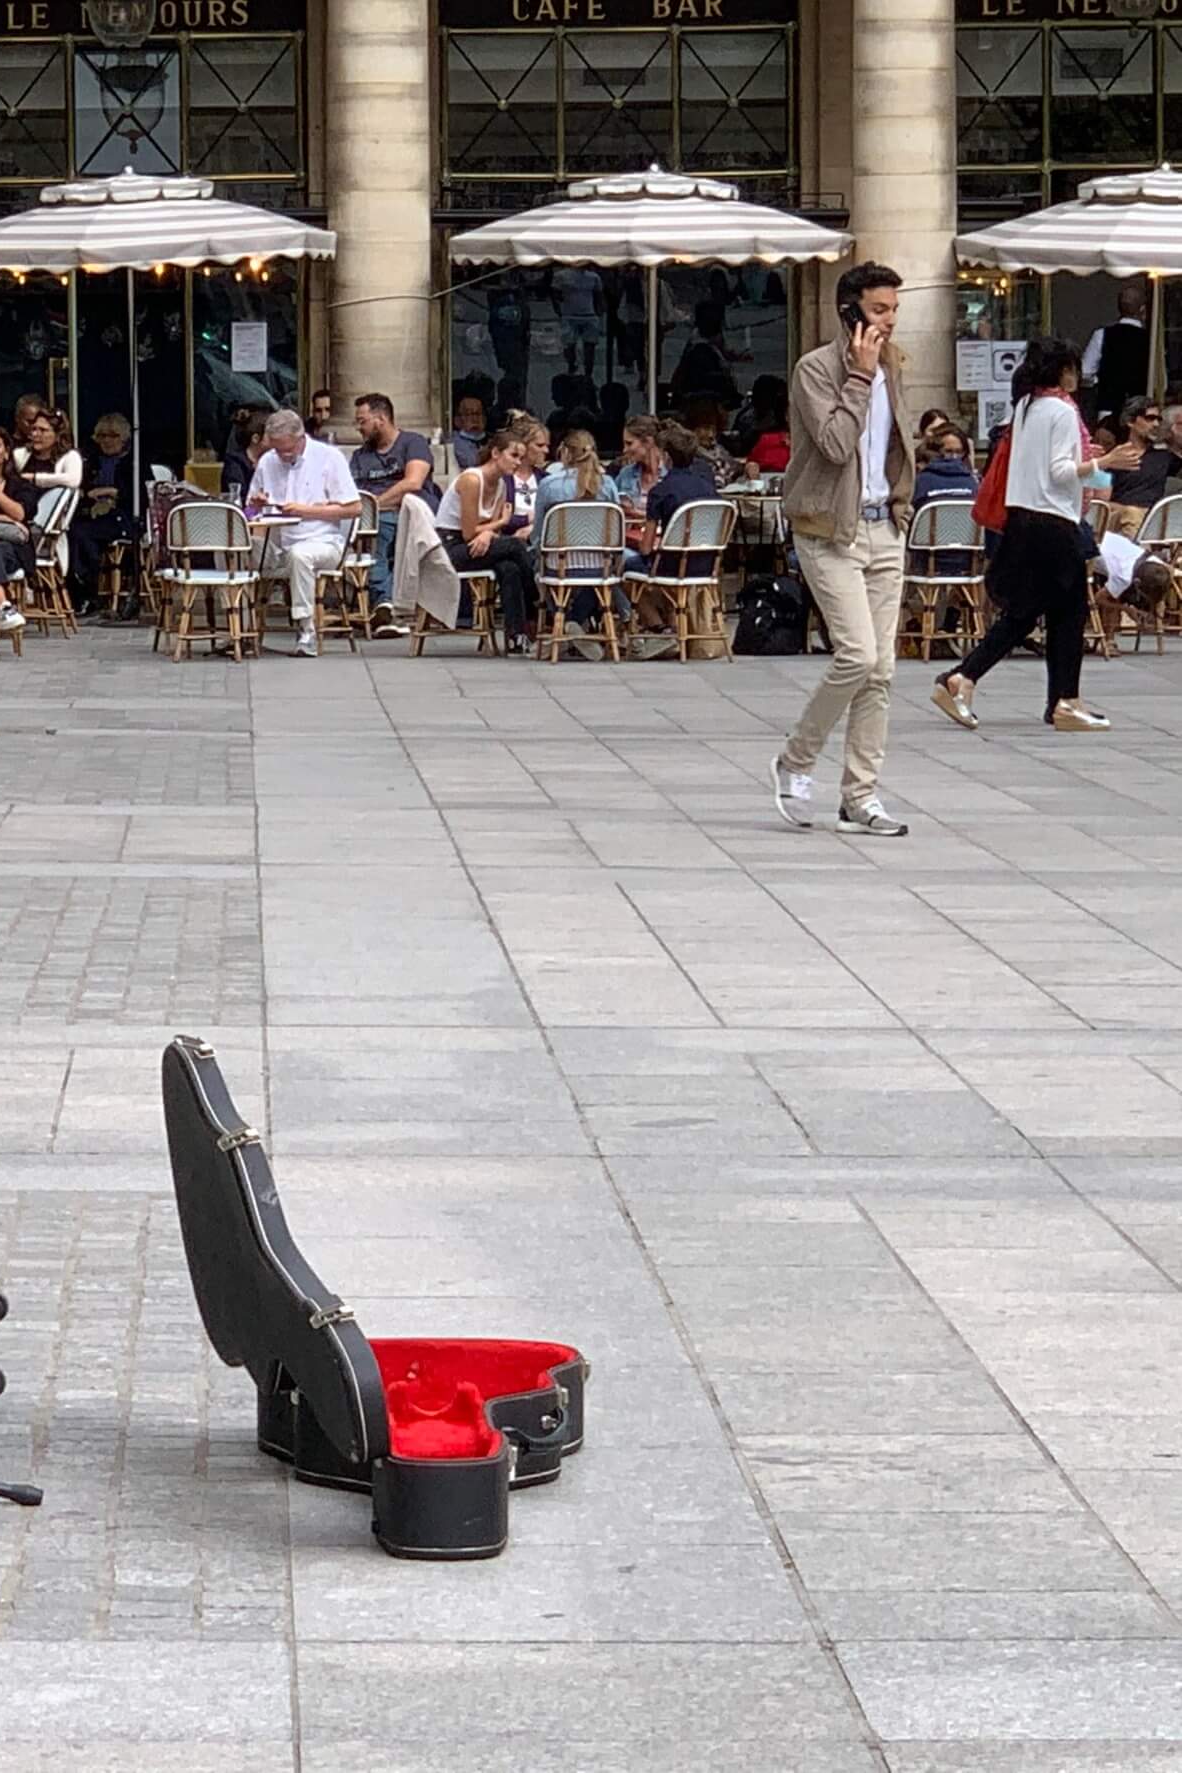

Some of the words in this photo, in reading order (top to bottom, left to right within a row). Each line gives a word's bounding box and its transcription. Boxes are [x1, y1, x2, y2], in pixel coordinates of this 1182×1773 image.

[7, 2, 51, 30] LE
[512, 0, 607, 21] CAFE
[651, 0, 723, 19] BAR
[981, 0, 1027, 16] LE
